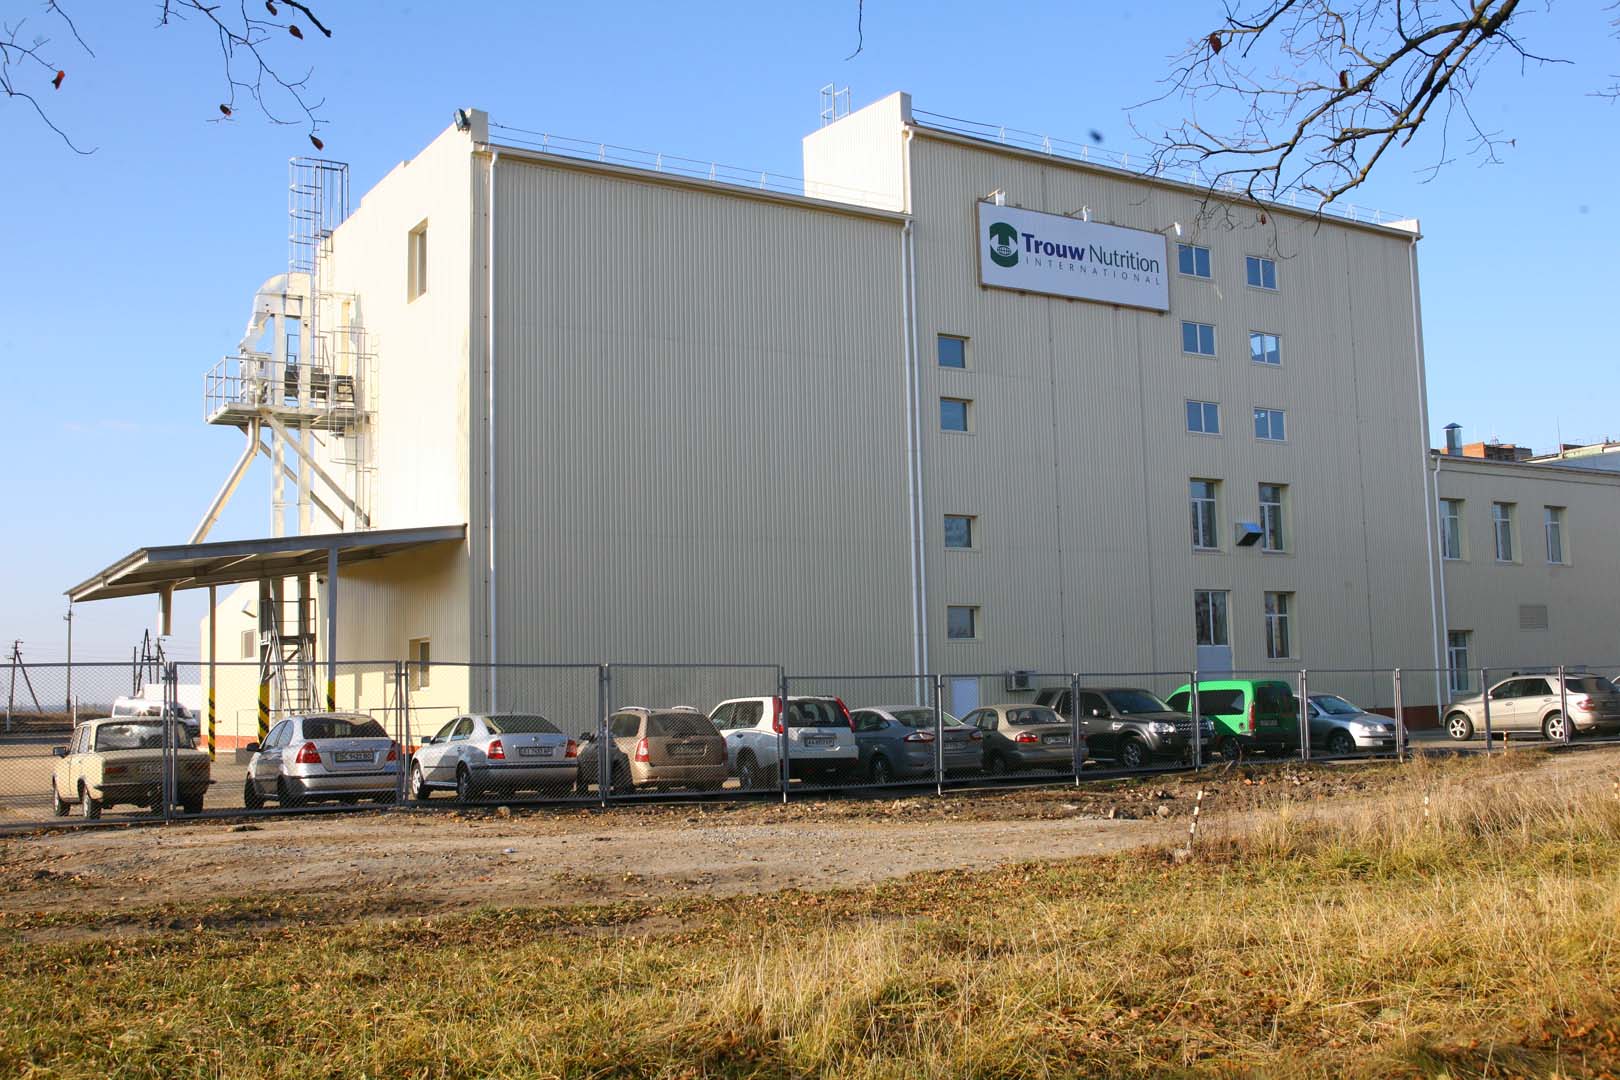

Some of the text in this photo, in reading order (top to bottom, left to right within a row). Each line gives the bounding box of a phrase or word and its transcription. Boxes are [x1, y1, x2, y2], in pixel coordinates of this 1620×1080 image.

[1021, 232, 1160, 274] Trouw Nutrition
[1026, 256, 1161, 286] INTERNATIONAL
